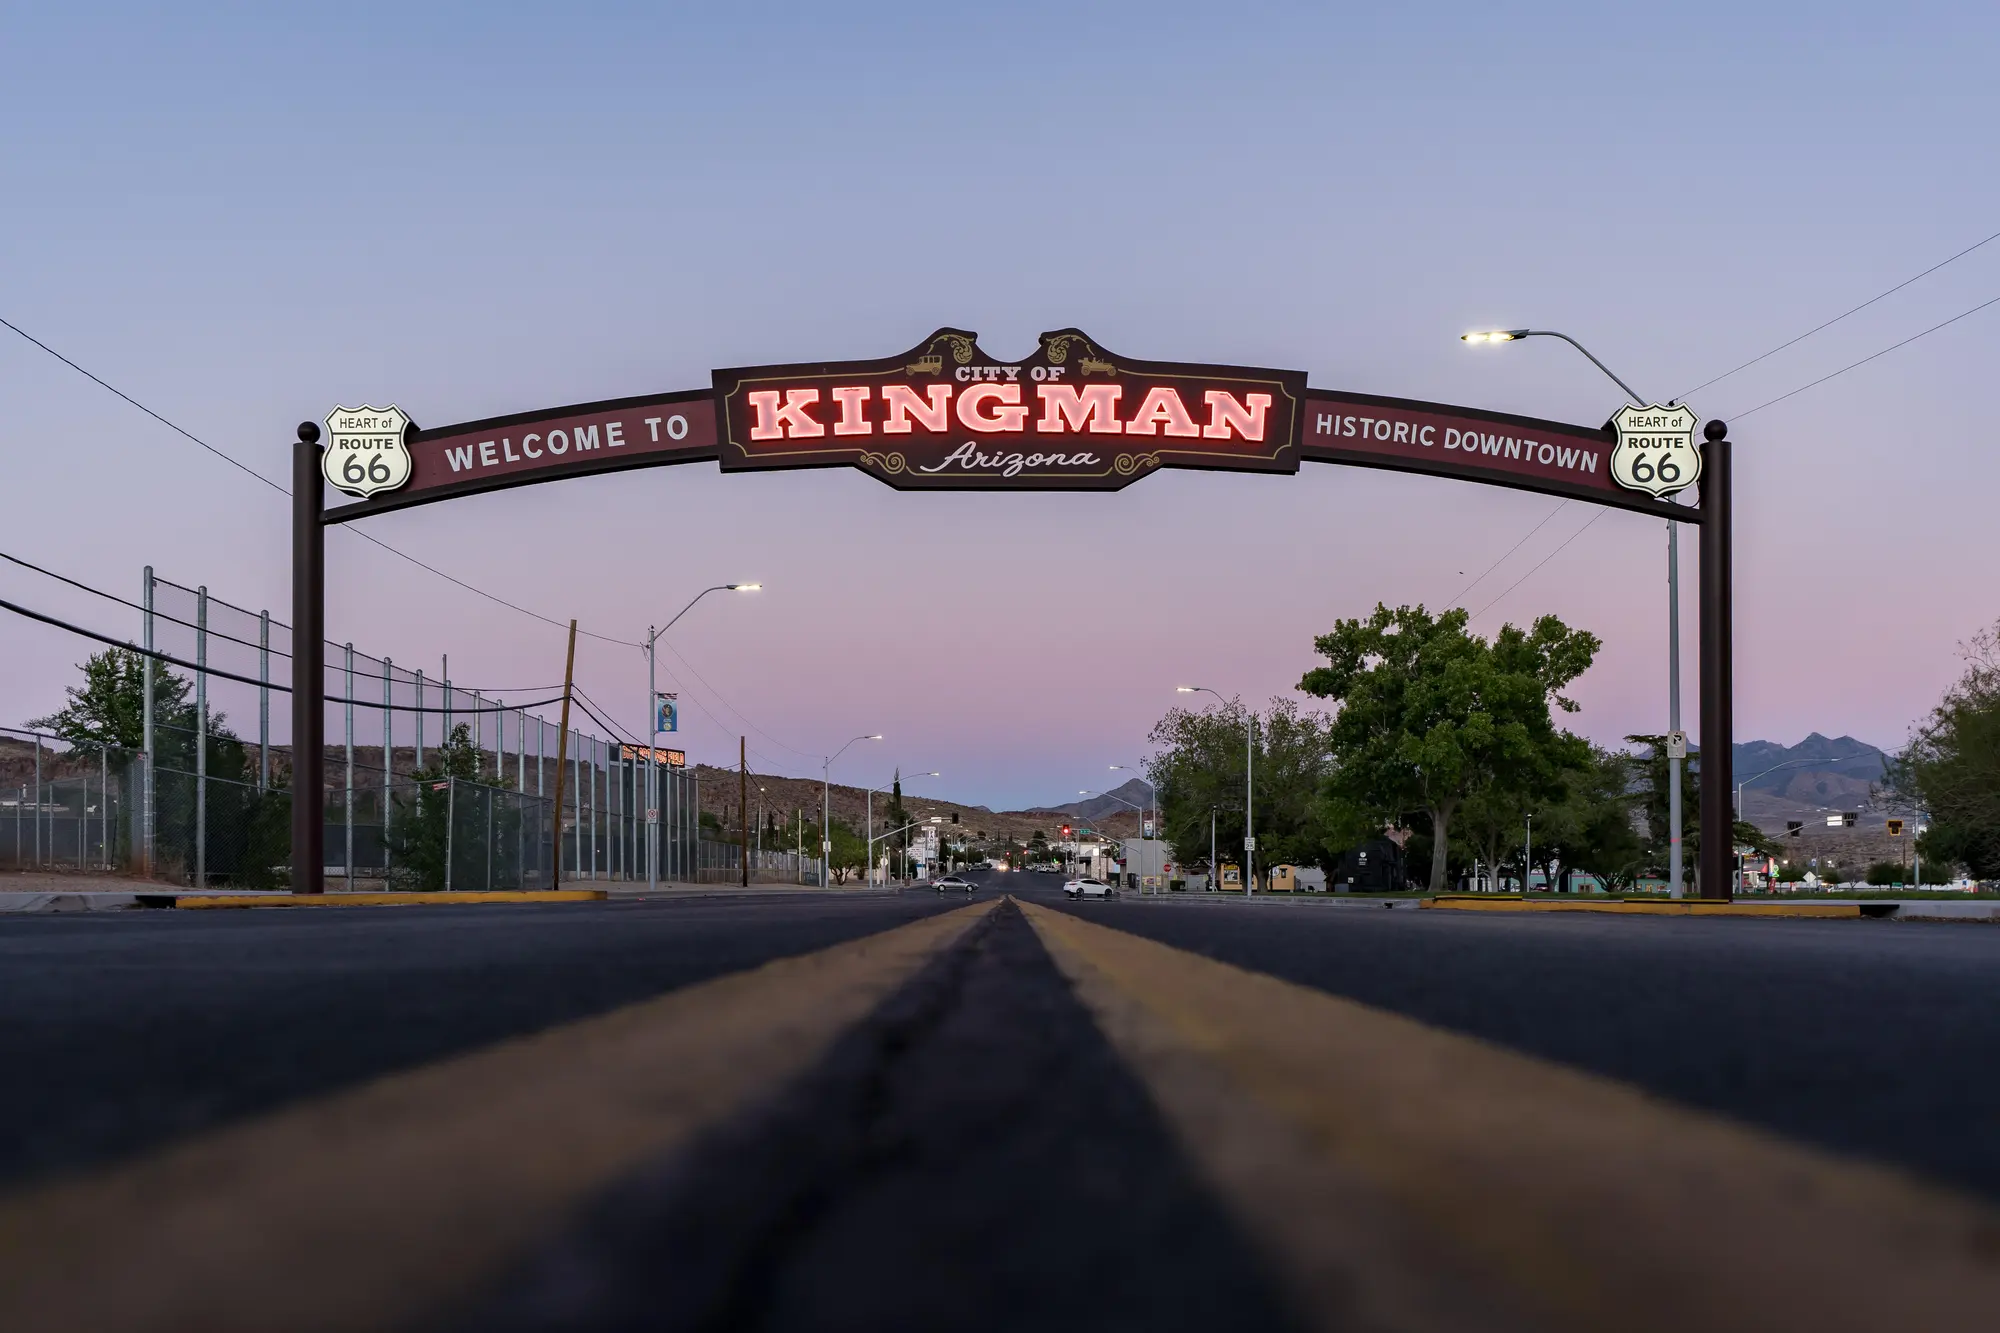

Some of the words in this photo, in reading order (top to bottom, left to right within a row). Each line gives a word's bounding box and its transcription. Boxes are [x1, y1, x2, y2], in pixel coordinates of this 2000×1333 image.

[955, 366, 1022, 382] CITY
[1030, 366, 1066, 382] OF
[339, 417, 378, 428] HEART
[381, 417, 393, 429] of
[749, 384, 1272, 441] KINGMAN
[1628, 416, 1668, 427] HEART
[1671, 416, 1683, 428] of
[339, 438, 394, 450] ROUTE
[445, 421, 626, 472] WELCOME
[644, 414, 689, 442] TO
[1316, 413, 1436, 447] HISTORIC
[1443, 428, 1599, 473] DOWNTOWN
[1628, 437, 1684, 449] ROUTE
[343, 452, 391, 484] 66
[919, 440, 1101, 478] Arizona
[1631, 452, 1681, 483] 66
